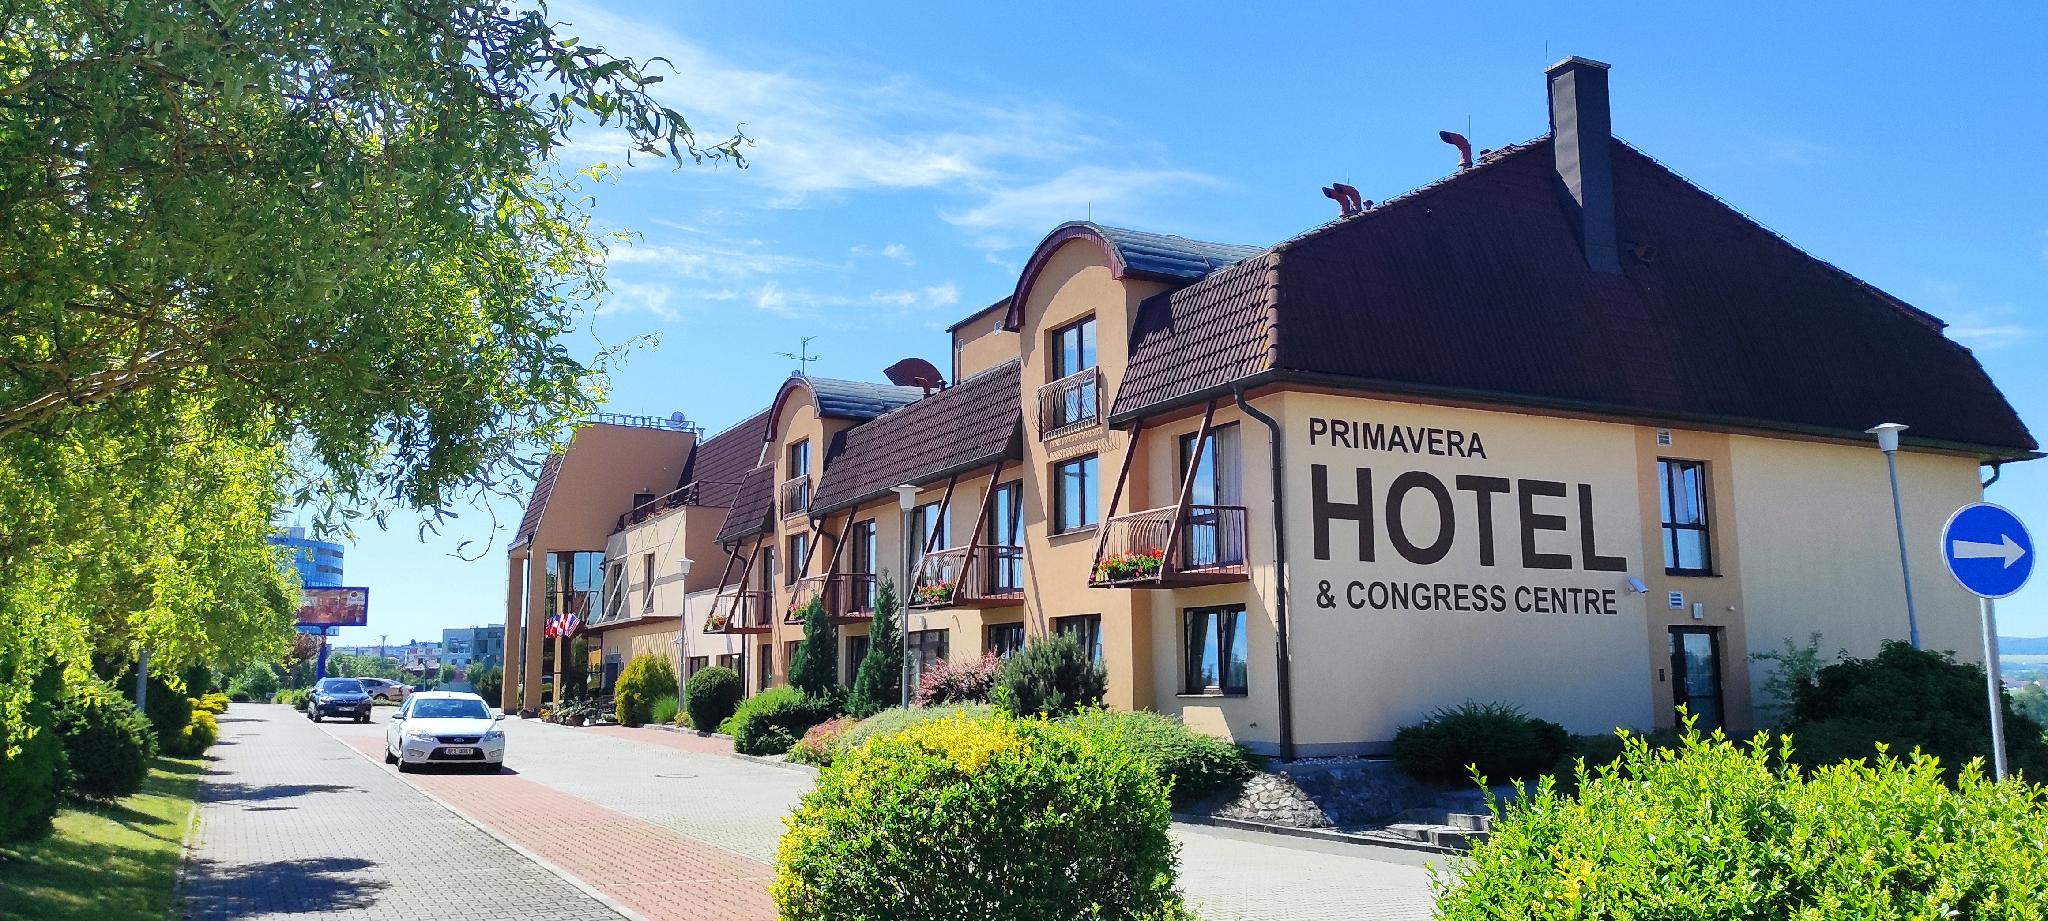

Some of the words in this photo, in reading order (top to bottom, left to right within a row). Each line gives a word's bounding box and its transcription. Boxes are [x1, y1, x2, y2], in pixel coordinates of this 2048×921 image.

[1309, 417, 1487, 459] PRIMAVERA
[1310, 463, 1628, 572] HOTEL
[1316, 579, 1337, 609] &
[1346, 580, 1507, 612] CONGRESS
[1515, 585, 1618, 615] CENTRE
